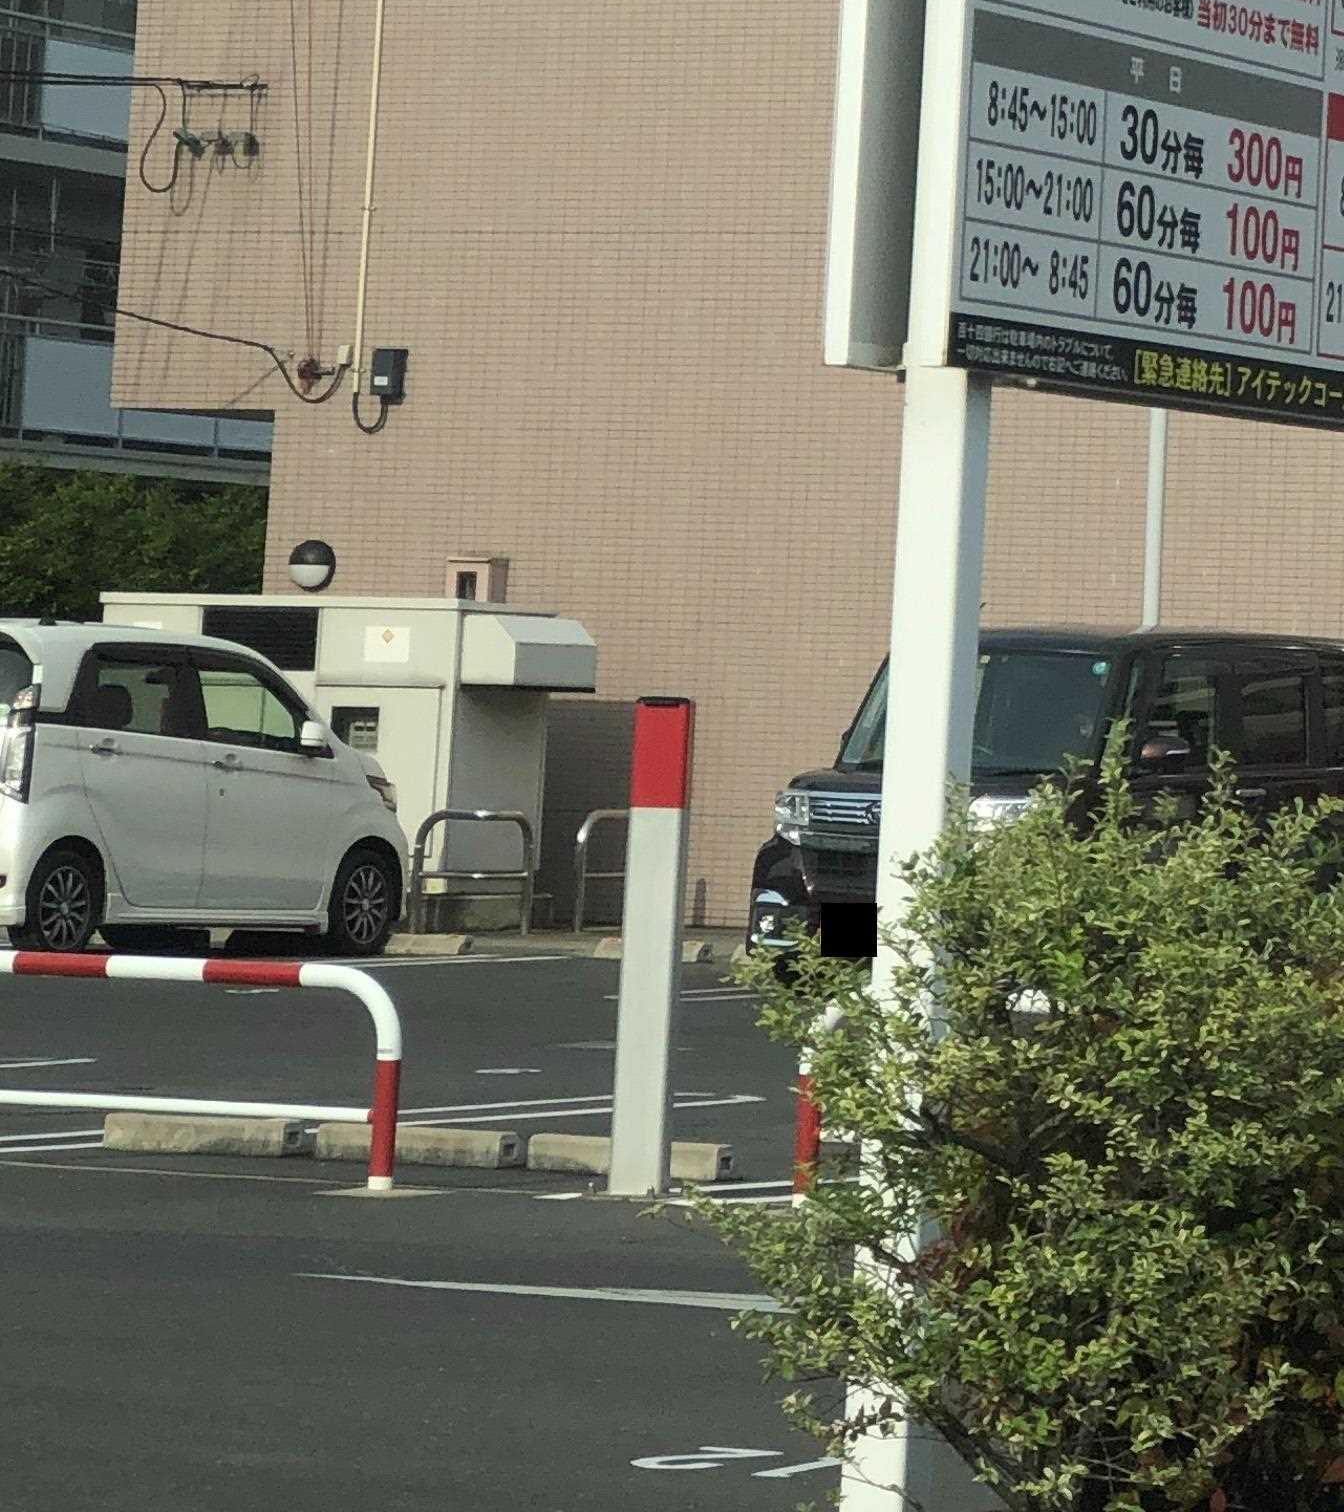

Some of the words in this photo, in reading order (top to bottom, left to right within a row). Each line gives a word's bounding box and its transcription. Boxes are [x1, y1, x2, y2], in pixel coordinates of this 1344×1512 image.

[1118, 102, 1206, 182] 30分毎
[1226, 125, 1305, 200] 300円
[1114, 180, 1202, 256] 60分毎
[1224, 204, 1301, 272] 100円
[1110, 256, 1199, 332] 60分毎
[1220, 276, 1298, 344] 100円
